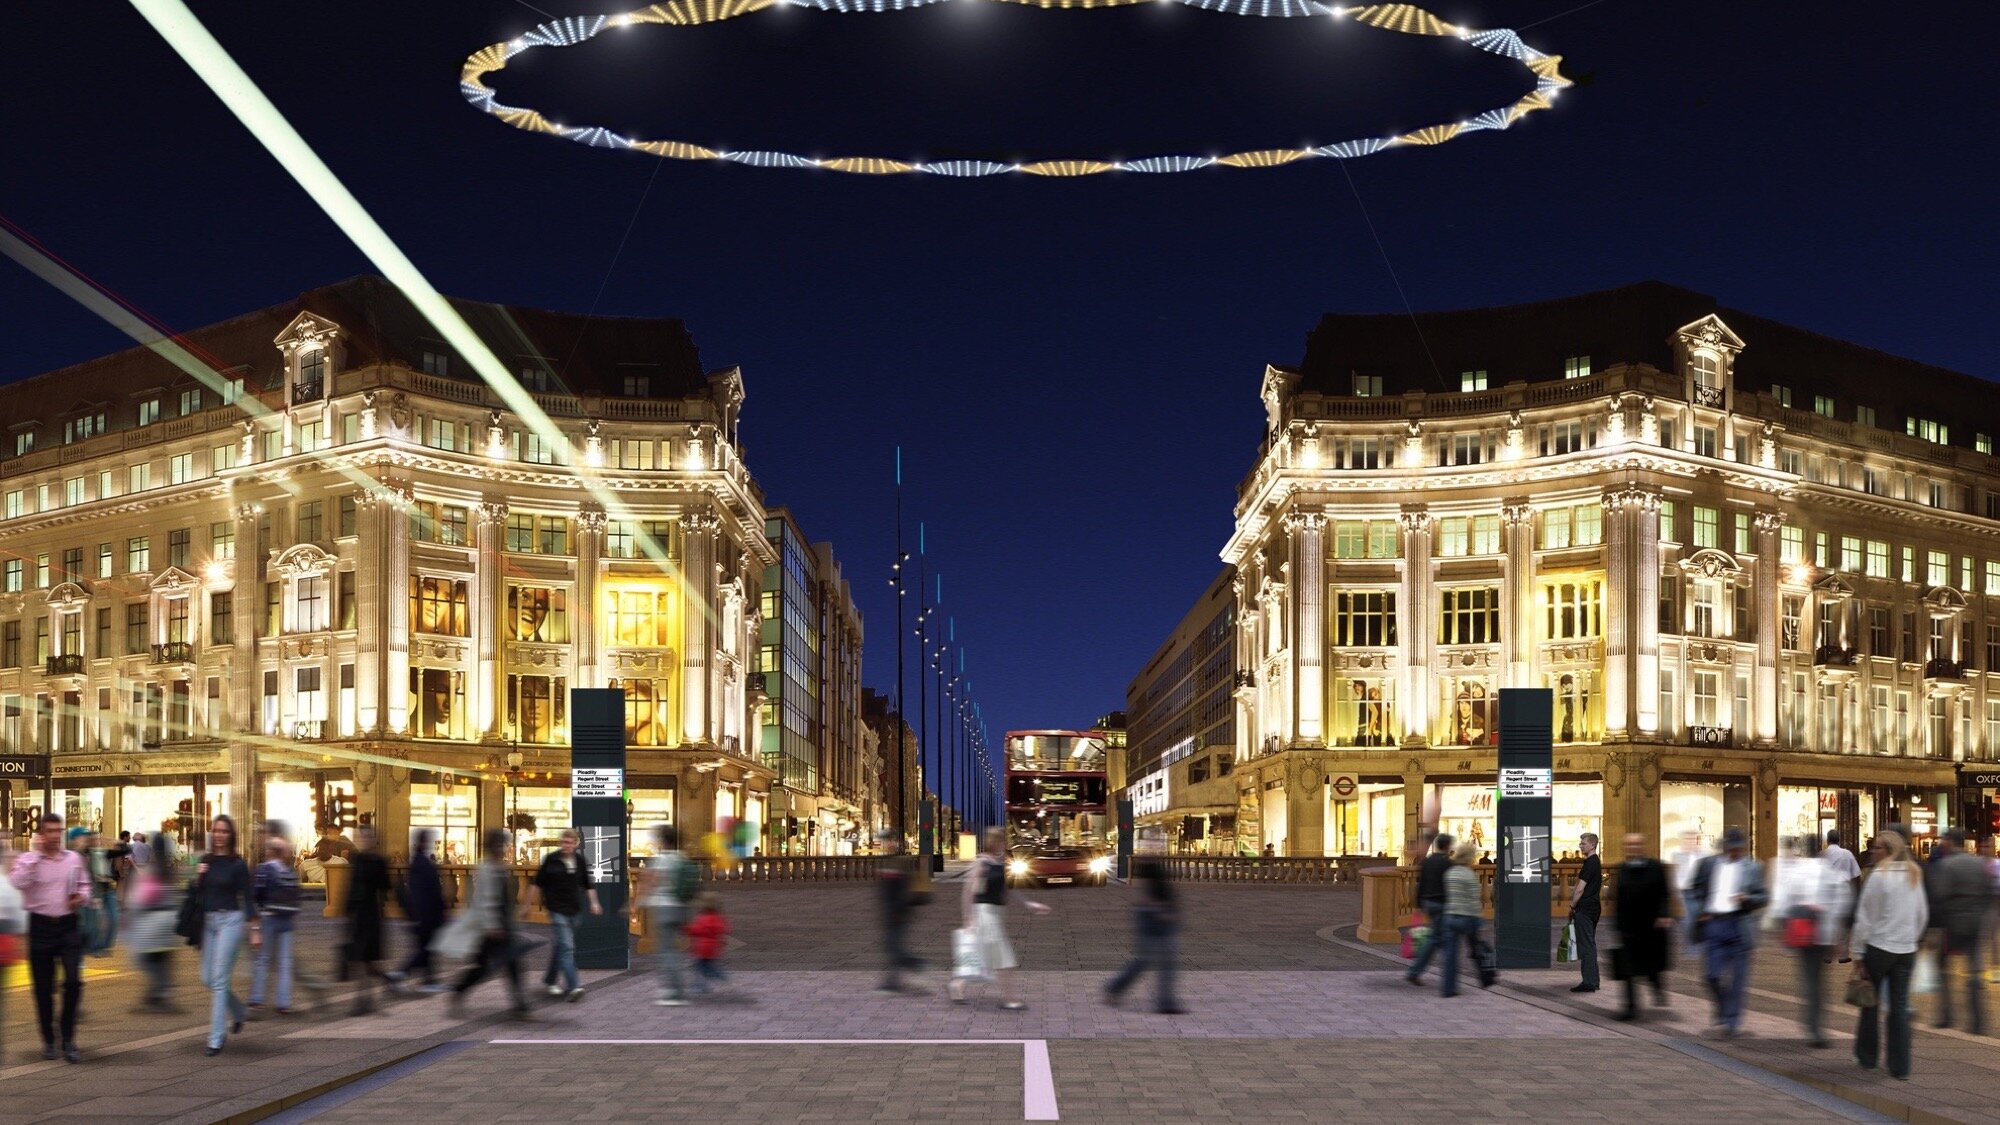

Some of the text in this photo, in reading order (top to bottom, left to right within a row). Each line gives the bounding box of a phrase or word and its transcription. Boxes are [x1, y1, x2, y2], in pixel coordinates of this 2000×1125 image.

[0, 762, 25, 772] ION
[55, 765, 101, 773] CONNECTION
[1458, 761, 1471, 770] H&M
[1468, 794, 1491, 811] H&M
